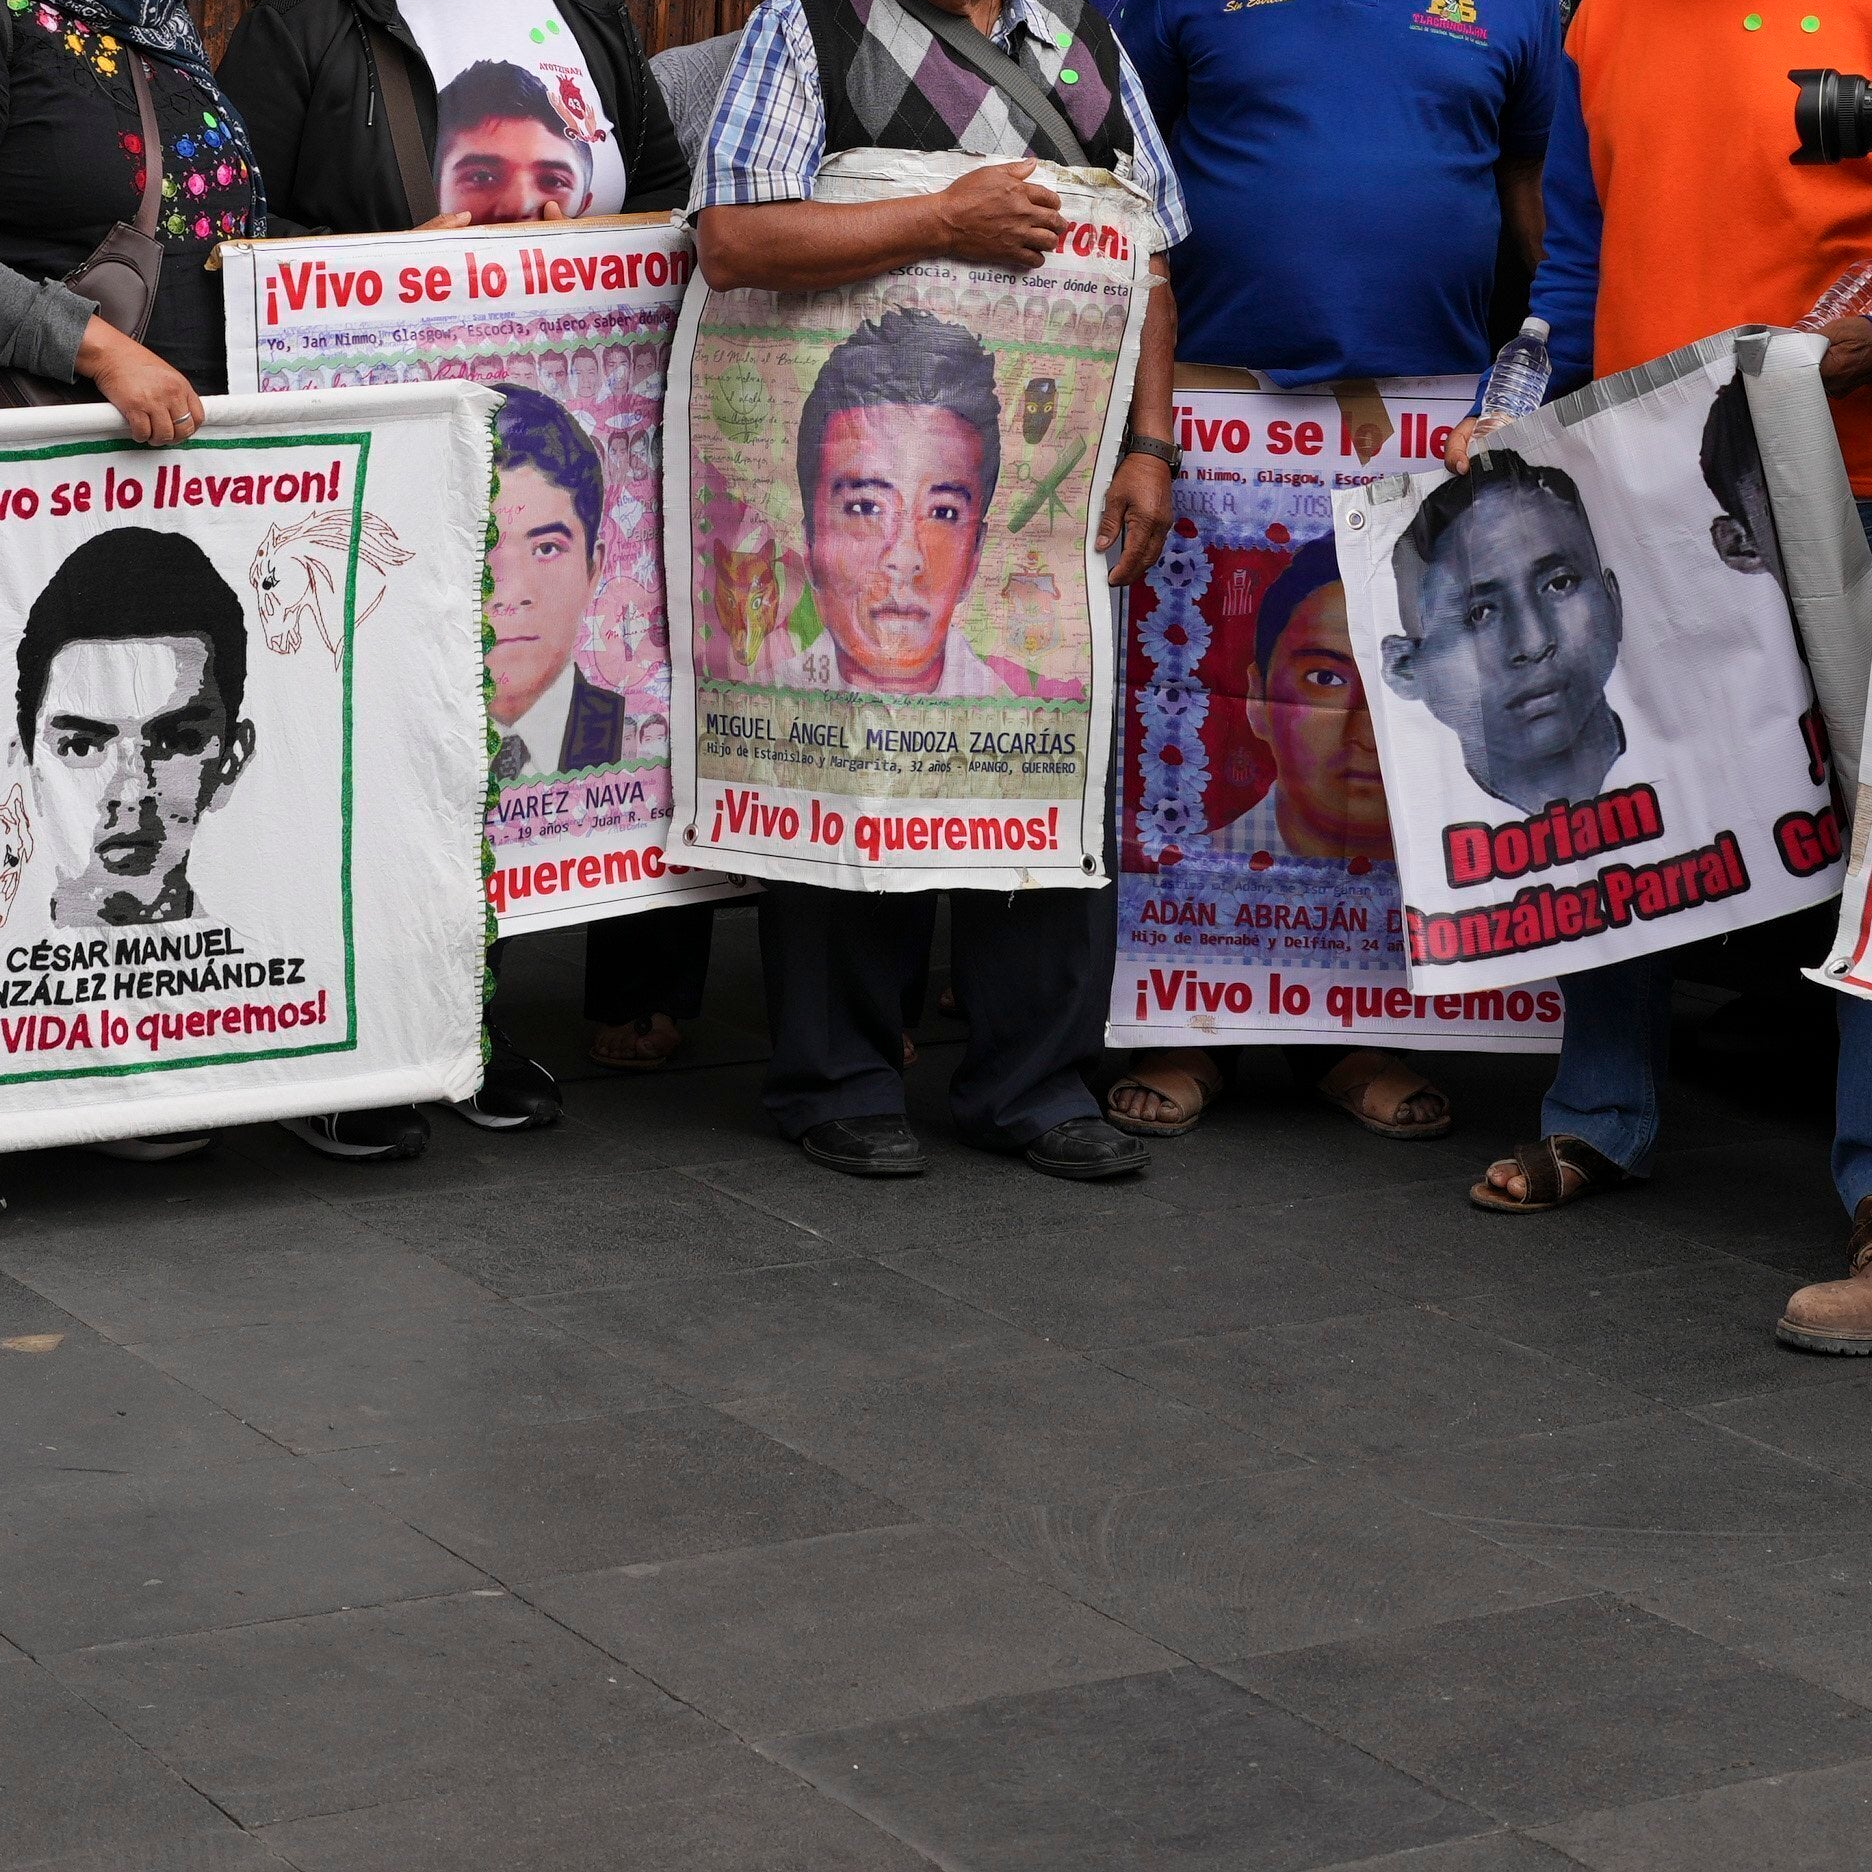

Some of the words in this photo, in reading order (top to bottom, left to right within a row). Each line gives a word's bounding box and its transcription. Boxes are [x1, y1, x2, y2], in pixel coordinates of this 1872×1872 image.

[265, 260, 383, 325] ¡Vivo
[398, 261, 453, 304] se
[465, 252, 508, 299] lo
[524, 248, 690, 295] llevaron
[969, 271, 1016, 285] quiero
[1022, 276, 1057, 289] saber
[1063, 279, 1098, 294] dónde
[267, 337, 292, 353] Yo,
[302, 334, 328, 349] Jan
[335, 330, 383, 347] Nimmo,
[392, 326, 458, 343] Glasgow,
[467, 320, 531, 338] Escocia,
[539, 314, 588, 334] quiero
[593, 313, 630, 329] saber
[1172, 406, 1250, 455] ivo
[1265, 419, 1324, 456] se
[50, 481, 91, 516] se
[105, 466, 143, 511] lo
[153, 460, 340, 509] llevaron!
[1197, 469, 1246, 484] Nimmo,
[1257, 471, 1325, 486] Glasgow,
[802, 653, 830, 686] 43
[707, 714, 776, 741] MIGUEL
[788, 717, 849, 749] ÁNGEL
[866, 728, 959, 753] MENDOZA
[970, 728, 1076, 755] ZACARÍAS
[707, 741, 732, 757] Hijo
[736, 746, 749, 758] de
[754, 748, 814, 765] Estanislao
[818, 755, 826, 769] y
[830, 756, 902, 774] Margarita,
[910, 760, 923, 773] 32
[928, 760, 951, 773] años
[968, 760, 1013, 776] APANGO,
[1022, 761, 1076, 774] GUERRERO
[585, 780, 645, 810] NAVA
[518, 827, 532, 840] 19
[540, 823, 569, 837] años
[591, 815, 621, 828] Juan
[628, 810, 642, 822] R.
[710, 788, 799, 842] ¡Vivo
[810, 799, 844, 846] lo
[854, 807, 1059, 861] queremos!
[1443, 782, 1664, 889] Doriam
[1598, 829, 1750, 928] Parral
[1140, 896, 1216, 926] ADÁN
[1234, 900, 1368, 932] ABRAJÁN
[6, 939, 109, 974] CÉSAR
[114, 927, 244, 966] MANUEL
[1131, 932, 1166, 946] Hijo
[1174, 933, 1192, 945] de
[1199, 933, 1260, 946] Bernabé
[1268, 937, 1277, 950] y
[1284, 936, 1352, 952] Delfina,
[1362, 939, 1379, 951] 24
[113, 957, 306, 1000] HERNÁNDEZ
[1135, 969, 1252, 1021] ¡Vivo
[1269, 973, 1311, 1017] lo
[0, 1009, 94, 1056] VIDA
[101, 1009, 128, 1048] lo
[136, 990, 327, 1051] queremos!
